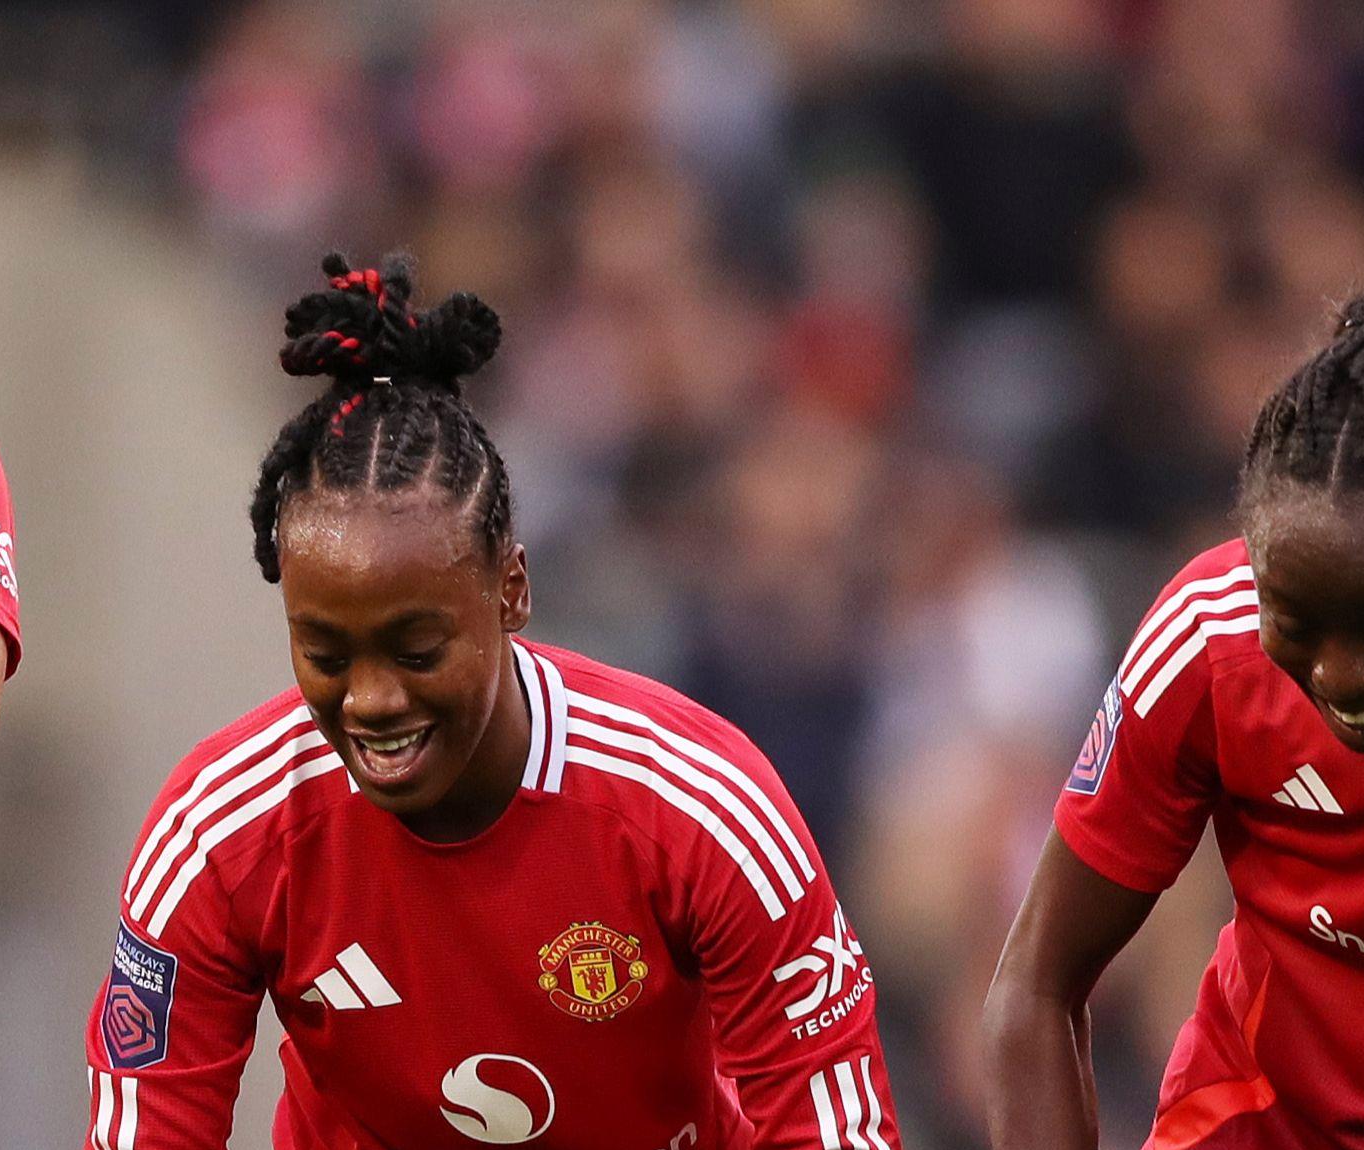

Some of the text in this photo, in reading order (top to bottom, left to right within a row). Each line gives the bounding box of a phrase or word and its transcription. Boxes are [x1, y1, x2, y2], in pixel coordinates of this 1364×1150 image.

[115, 943, 164, 985] WOMEN'S
[122, 937, 166, 973] BARCLAYS
[547, 929, 634, 966] MANCHESTER
[569, 995, 629, 1016] UNITED
